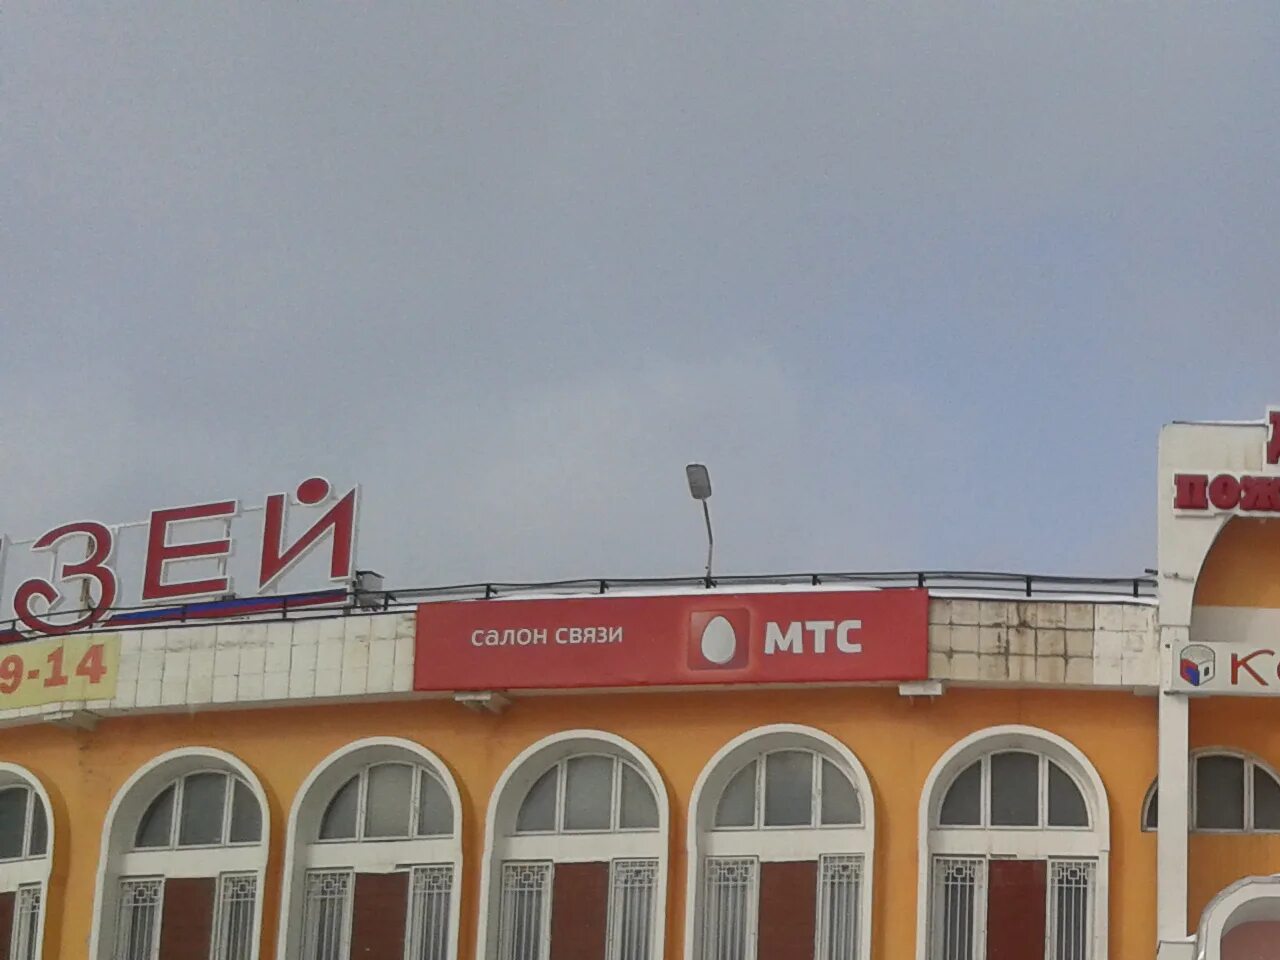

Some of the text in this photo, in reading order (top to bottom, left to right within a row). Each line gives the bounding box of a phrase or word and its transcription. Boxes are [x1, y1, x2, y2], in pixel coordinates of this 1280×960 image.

[0, 476, 360, 635] ЗЕЙ
[470, 625, 624, 648] салон связи
[763, 618, 863, 655] МТС
